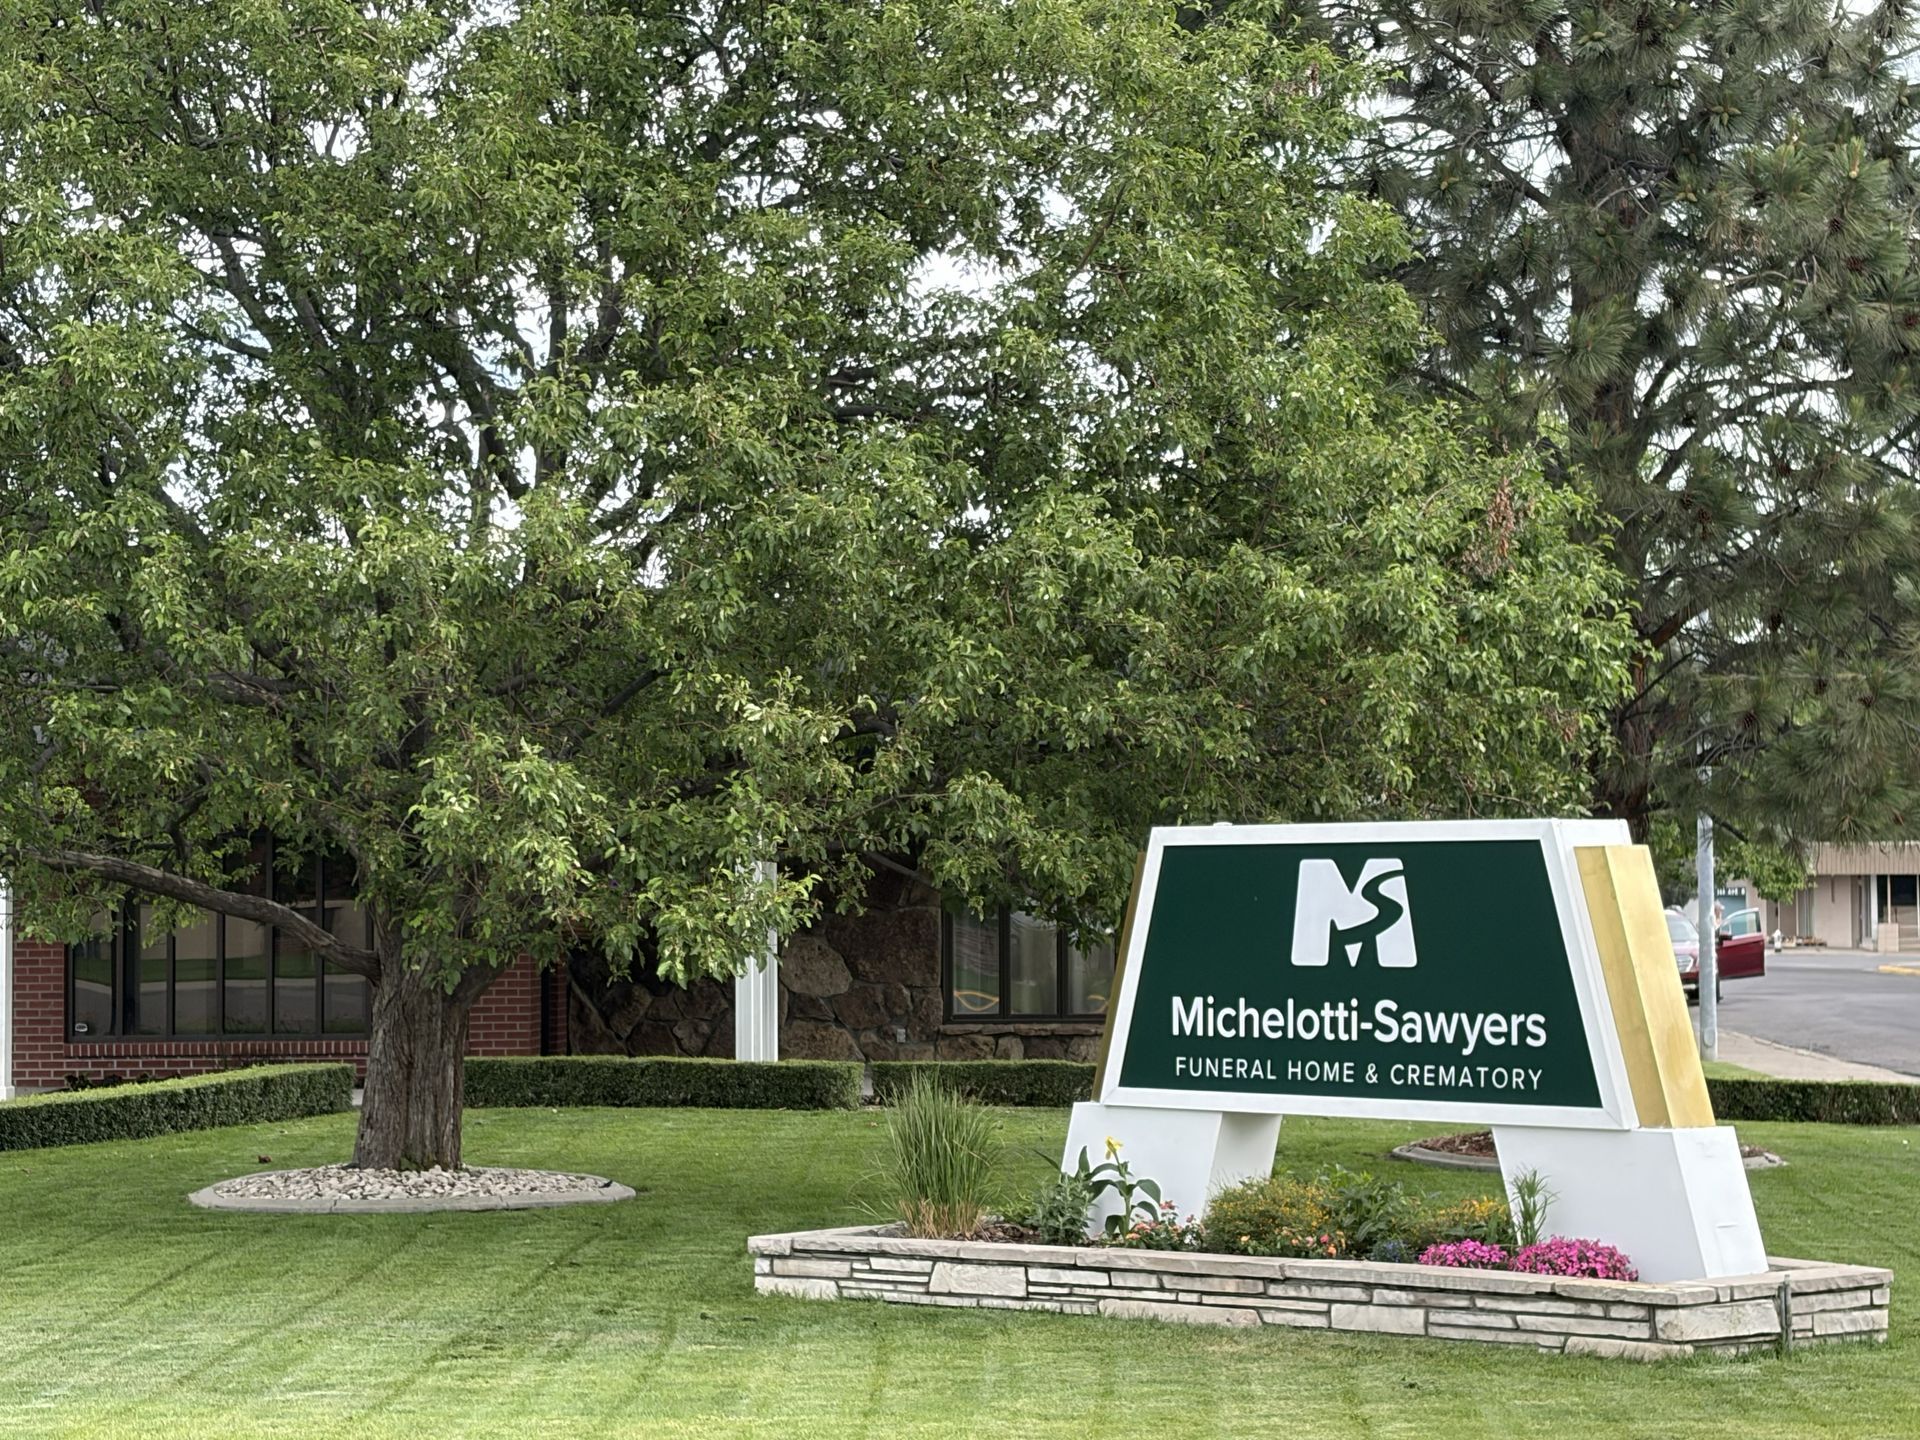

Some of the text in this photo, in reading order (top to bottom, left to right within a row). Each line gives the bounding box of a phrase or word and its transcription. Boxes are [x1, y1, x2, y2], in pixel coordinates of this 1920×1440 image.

[1171, 995, 1548, 1056] Michelotti-Sawyers
[1175, 1056, 1544, 1091] FUNERAL HOME & CREMATORY
